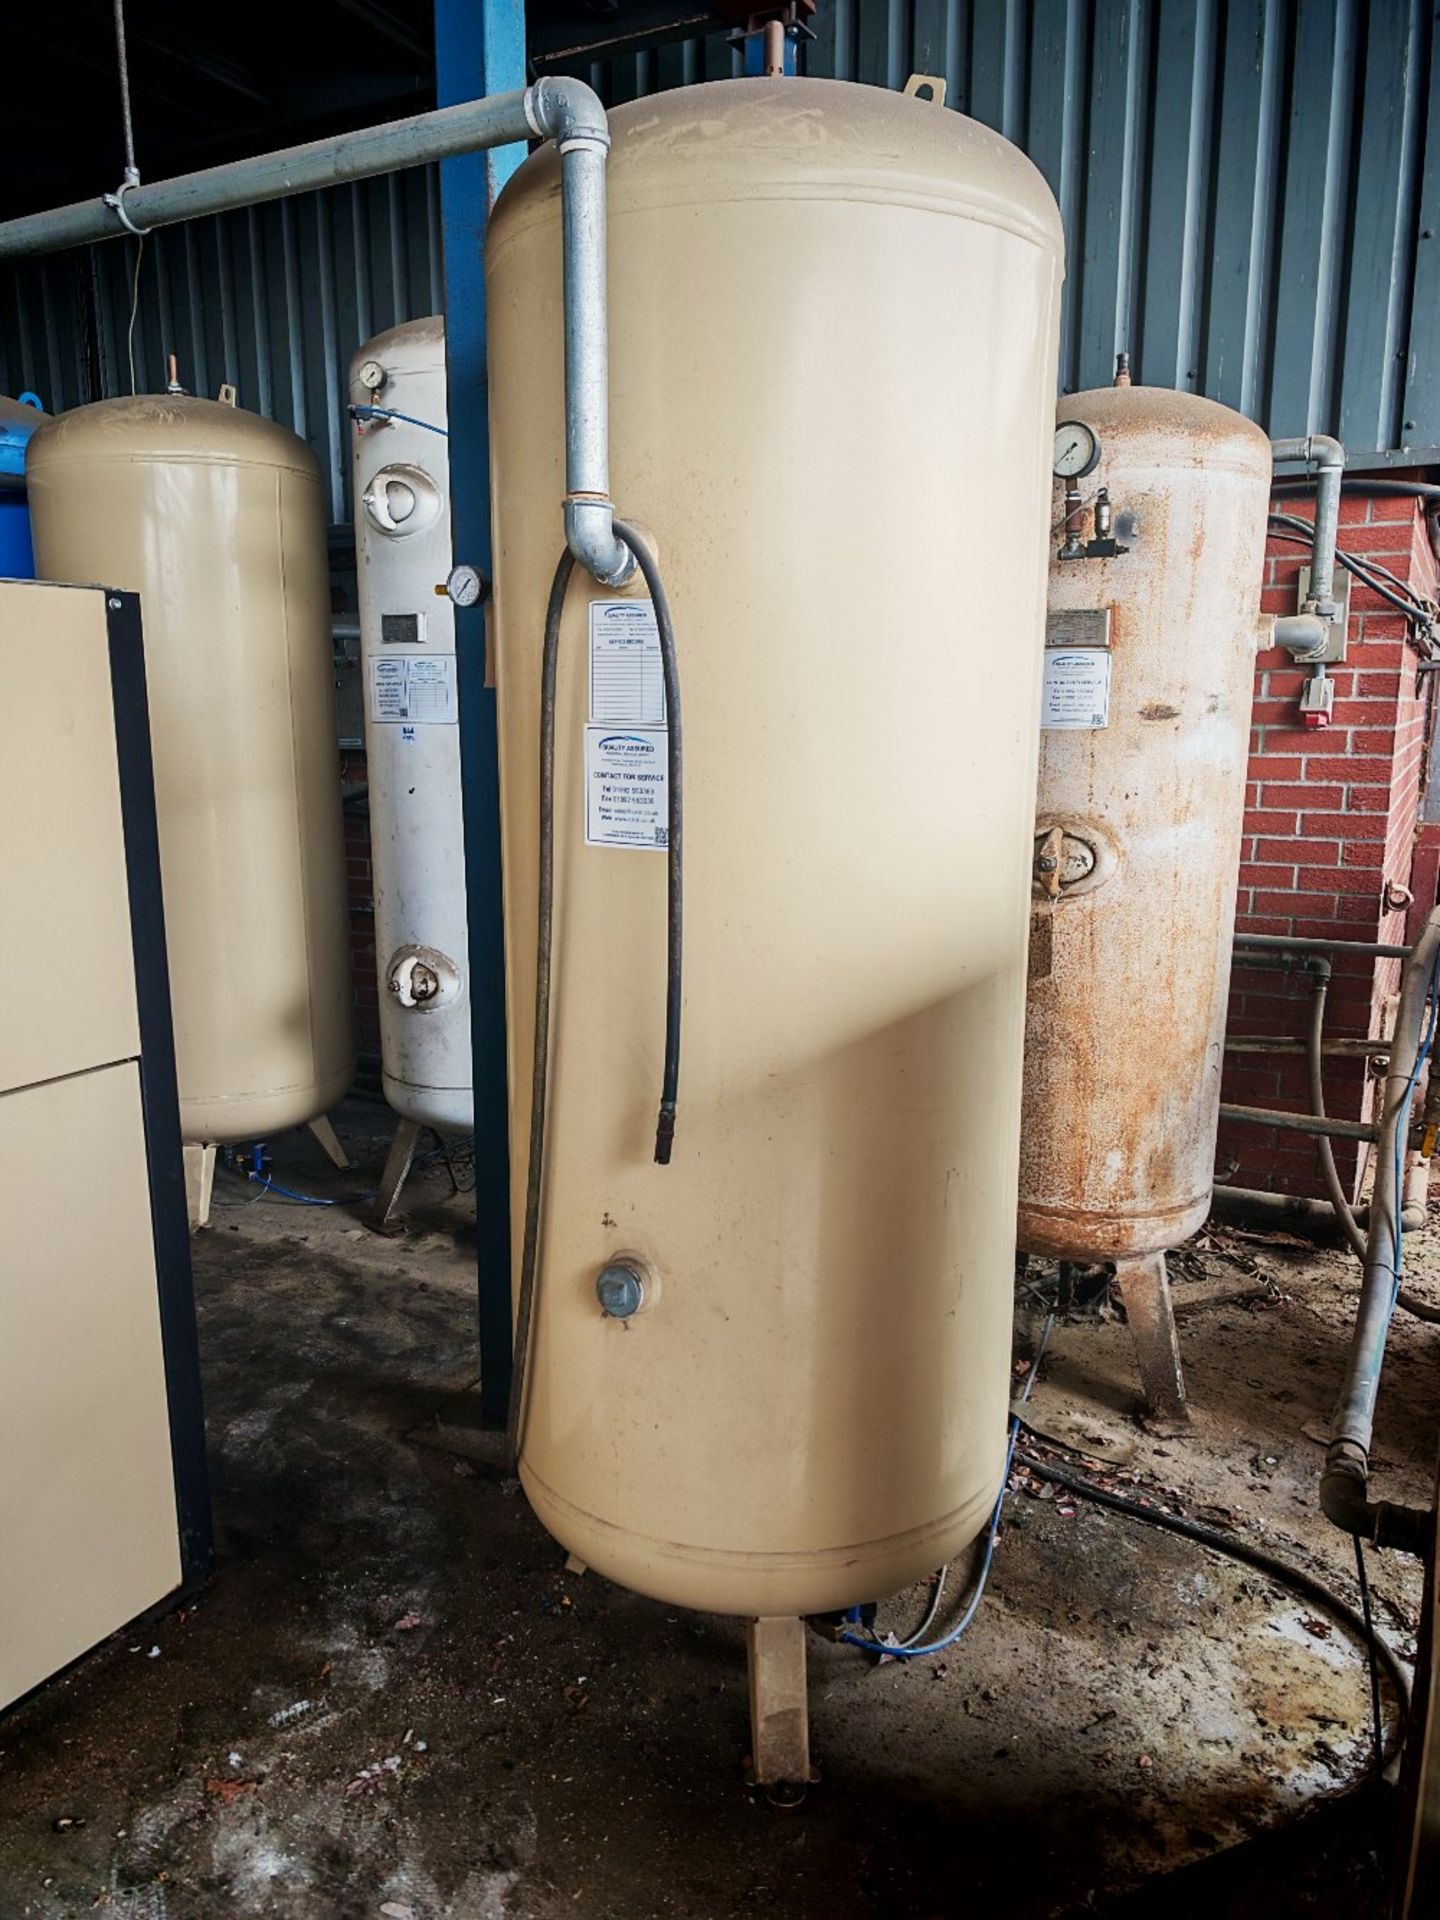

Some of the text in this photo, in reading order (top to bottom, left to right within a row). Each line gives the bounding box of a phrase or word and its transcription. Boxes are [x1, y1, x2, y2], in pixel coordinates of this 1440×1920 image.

[602, 744, 655, 753] QUALITY ASSURED
[593, 771, 621, 780] CONTACT
